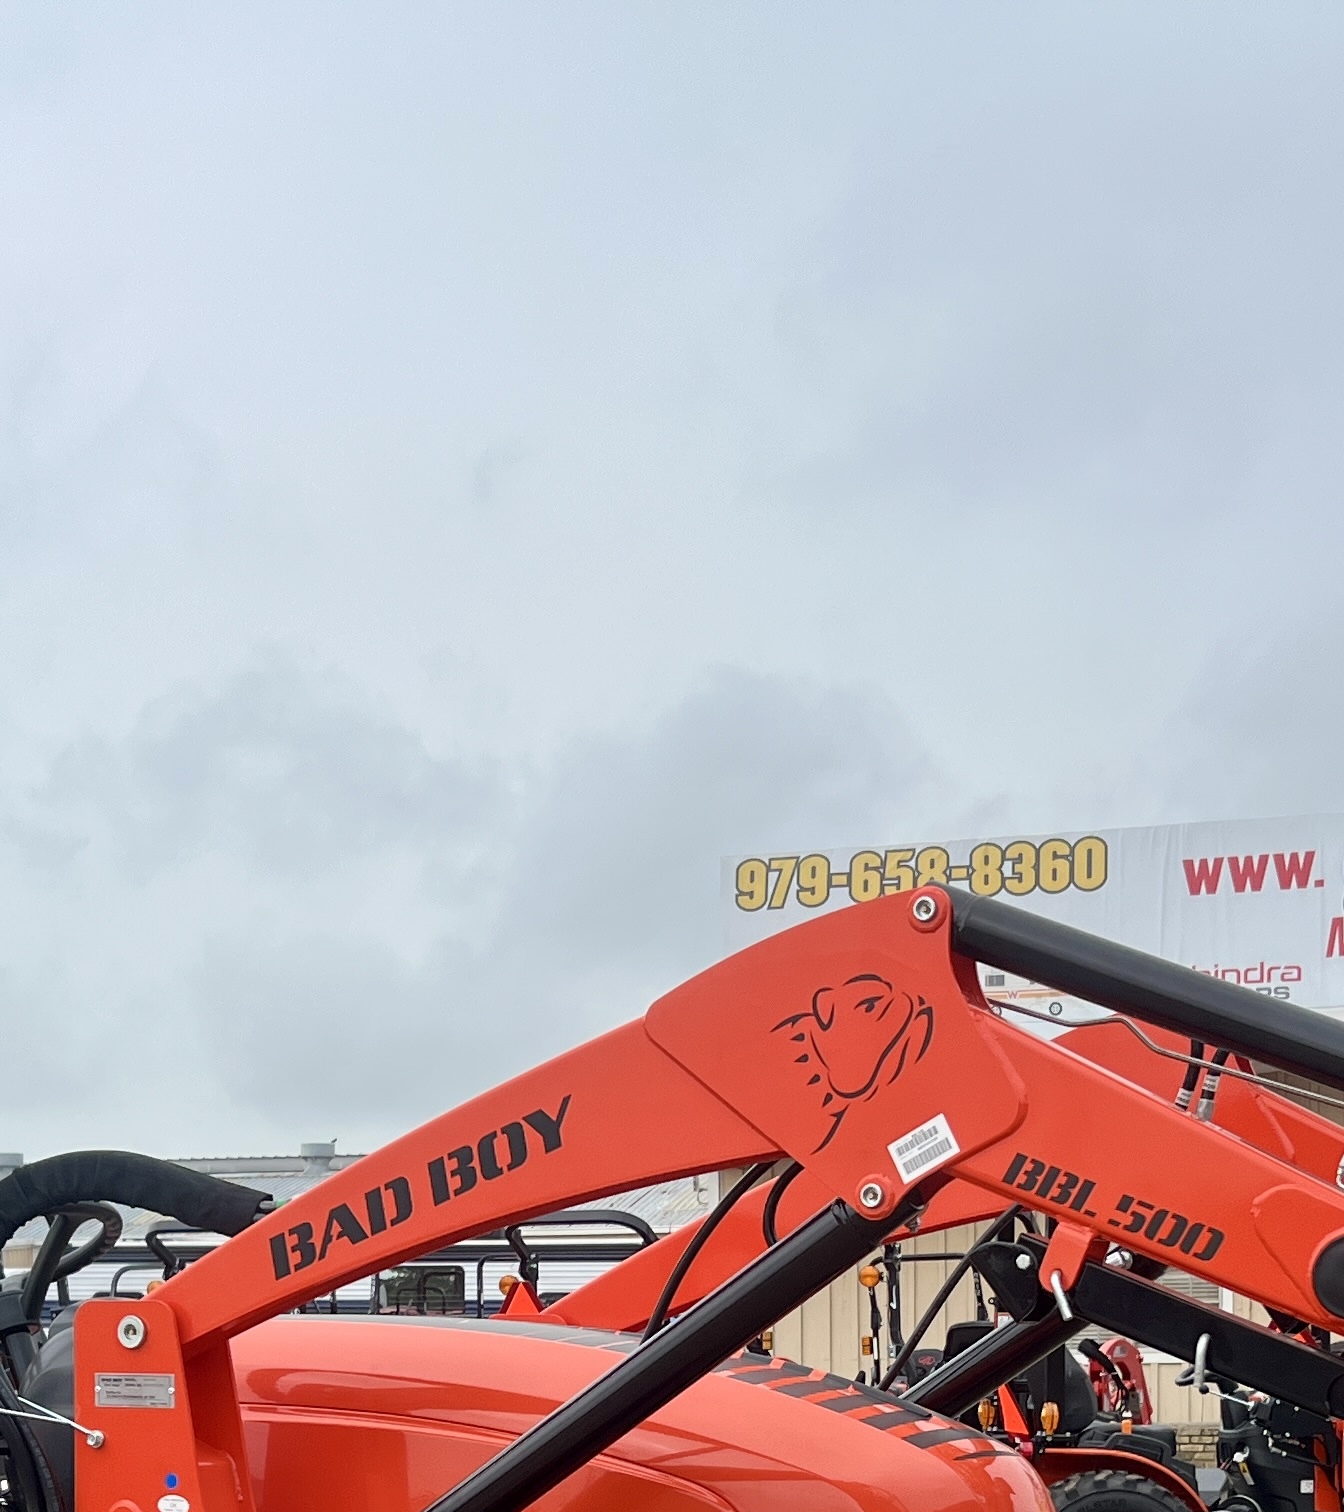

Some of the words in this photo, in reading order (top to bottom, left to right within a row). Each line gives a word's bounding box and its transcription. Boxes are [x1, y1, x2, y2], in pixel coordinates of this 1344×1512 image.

[735, 836, 1108, 912] 979-658-8360
[1182, 851, 1325, 896] www.
[268, 1175, 414, 1280] BAD
[427, 1094, 572, 1206] BOY
[1001, 1152, 1098, 1218] BBL
[1108, 1193, 1226, 1262] 500
